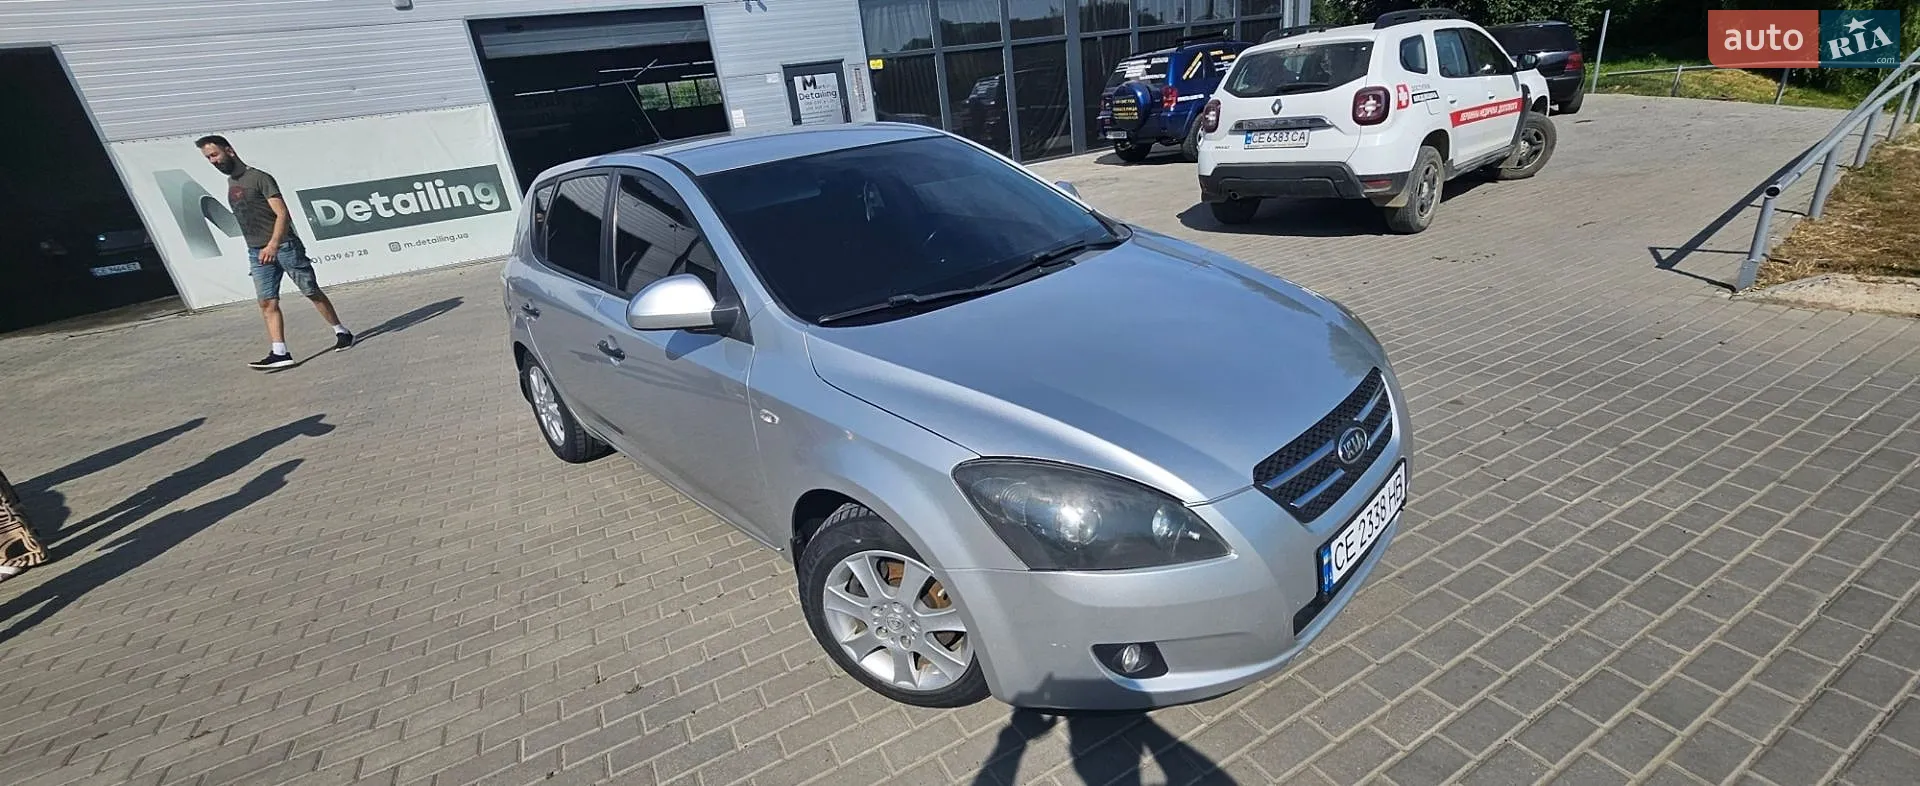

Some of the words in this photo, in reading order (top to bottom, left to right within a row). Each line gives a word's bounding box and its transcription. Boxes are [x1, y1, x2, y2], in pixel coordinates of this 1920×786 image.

[799, 90, 837, 100] Detailing
[1266, 132, 1289, 143] 6583
[311, 179, 500, 227] Detailing
[404, 232, 470, 249] m.detailing.ua
[1343, 432, 1364, 459] KIA
[1334, 529, 1355, 571] CE
[1358, 495, 1386, 548] 2338
[1388, 475, 1402, 514] HB
